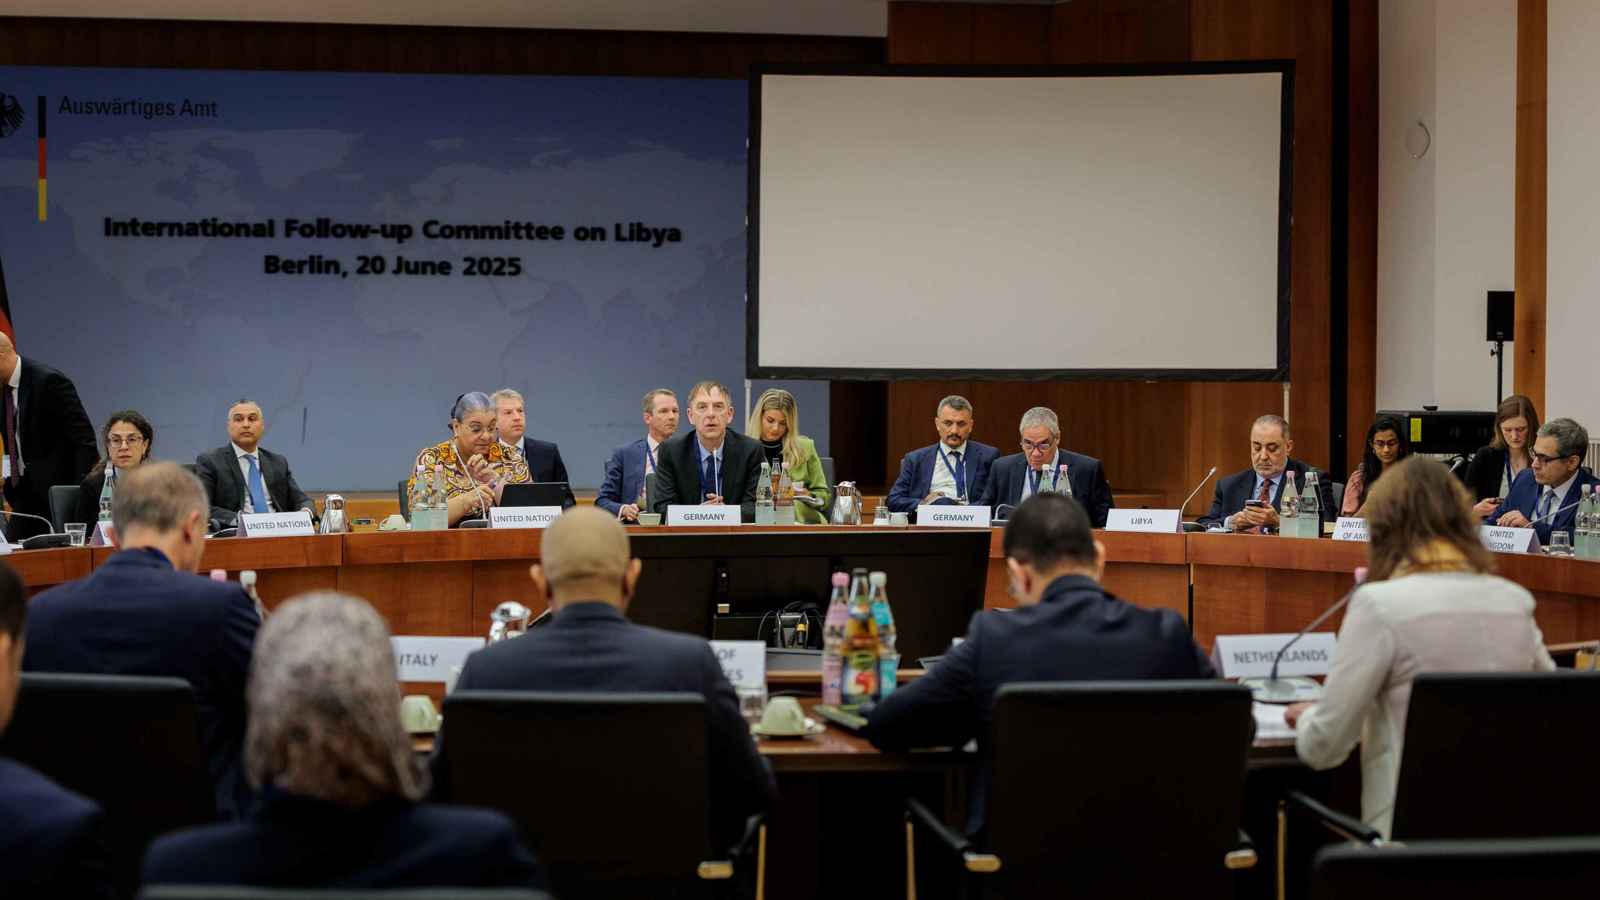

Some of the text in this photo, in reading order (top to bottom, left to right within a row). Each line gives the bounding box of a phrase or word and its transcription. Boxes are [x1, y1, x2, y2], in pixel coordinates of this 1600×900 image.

[58, 96, 218, 119] Auswärtiges Amt
[104, 217, 681, 247] International Follow-up Committee on Libya
[264, 255, 522, 278] Berlin, 20 June 2025
[493, 514, 523, 522] UNITED
[683, 513, 726, 521] GERMANY
[932, 513, 975, 521] GERMANY
[1131, 517, 1153, 525] LIBYA
[246, 520, 311, 530] UNITED NATIONS
[1489, 529, 1515, 538] UNITED
[400, 652, 439, 667] ITALY
